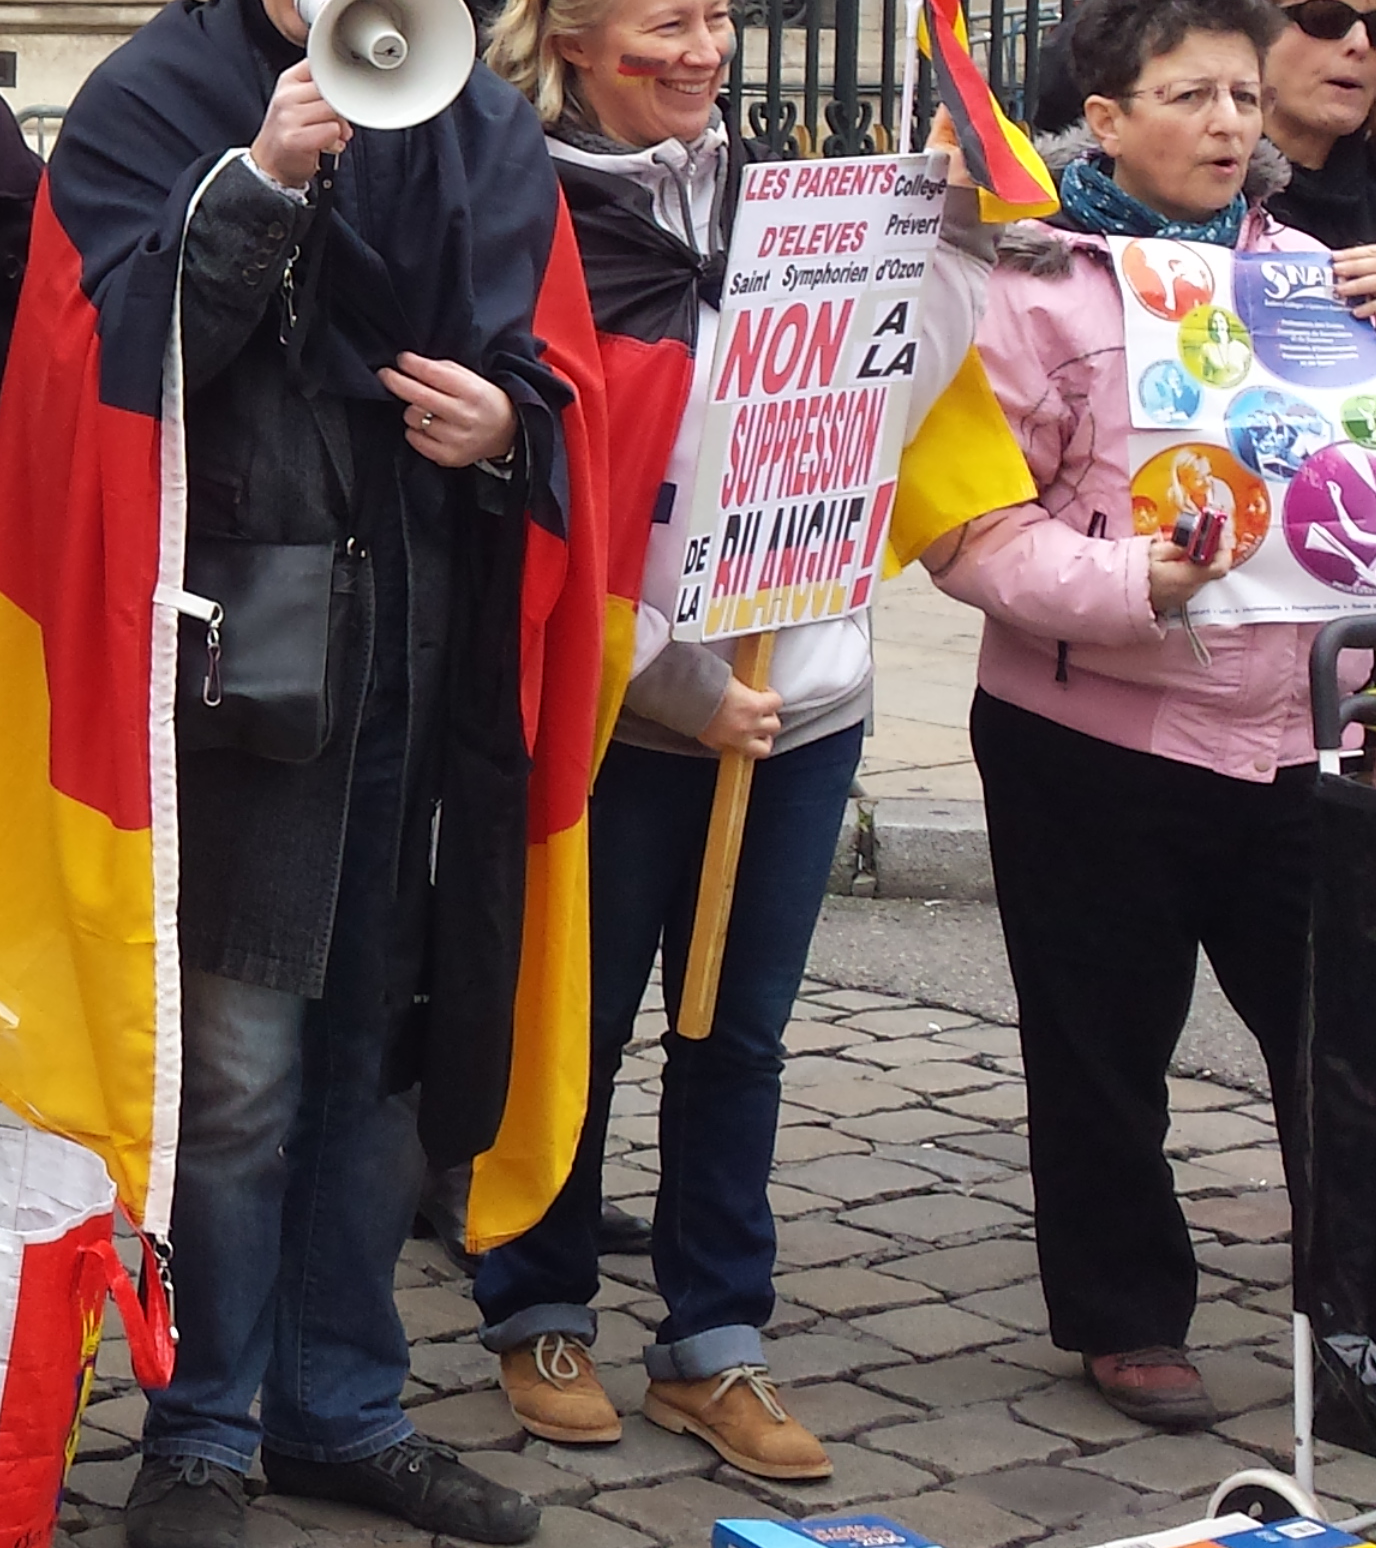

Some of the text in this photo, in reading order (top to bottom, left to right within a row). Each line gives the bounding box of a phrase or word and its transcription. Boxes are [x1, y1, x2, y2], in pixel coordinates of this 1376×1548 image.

[745, 163, 898, 201] LES PARENTS
[757, 220, 868, 259] D'ELEVES
[884, 212, 940, 236] Prévert
[729, 254, 925, 297] Saint Symphorien d'Ozon
[873, 301, 908, 336] A
[714, 299, 855, 402] NON
[856, 341, 917, 379] LA
[720, 386, 888, 510] SUPPRESSION
[683, 535, 712, 576] DE
[705, 496, 866, 635] BILANGUE
[676, 585, 701, 624] LA
